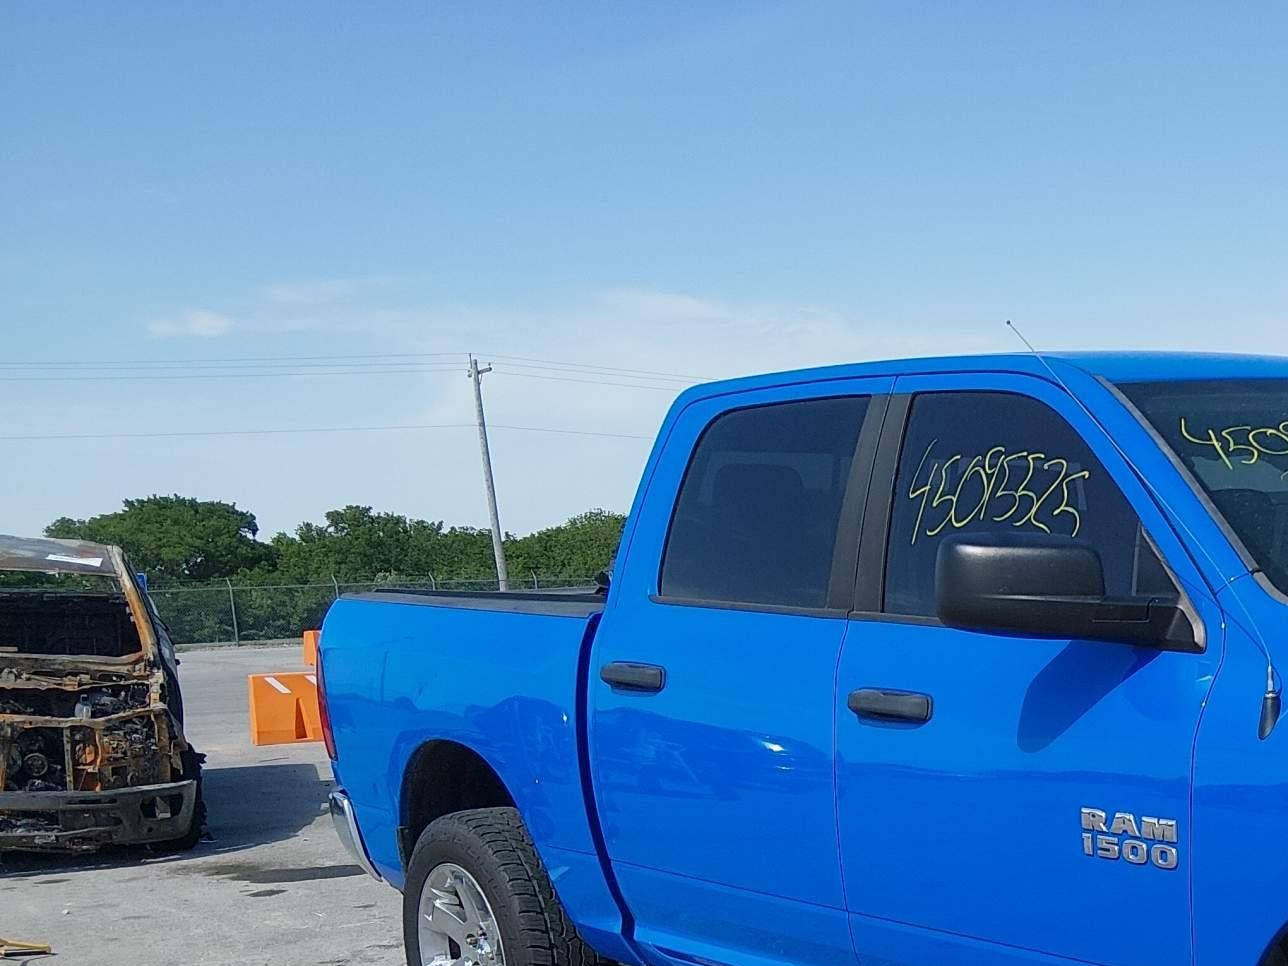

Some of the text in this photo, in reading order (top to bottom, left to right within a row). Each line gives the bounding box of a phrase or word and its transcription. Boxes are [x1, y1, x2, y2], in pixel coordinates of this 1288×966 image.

[908, 439, 1090, 545] 45095525
[1080, 807, 1179, 843] RAM
[1081, 832, 1179, 870] 1500
